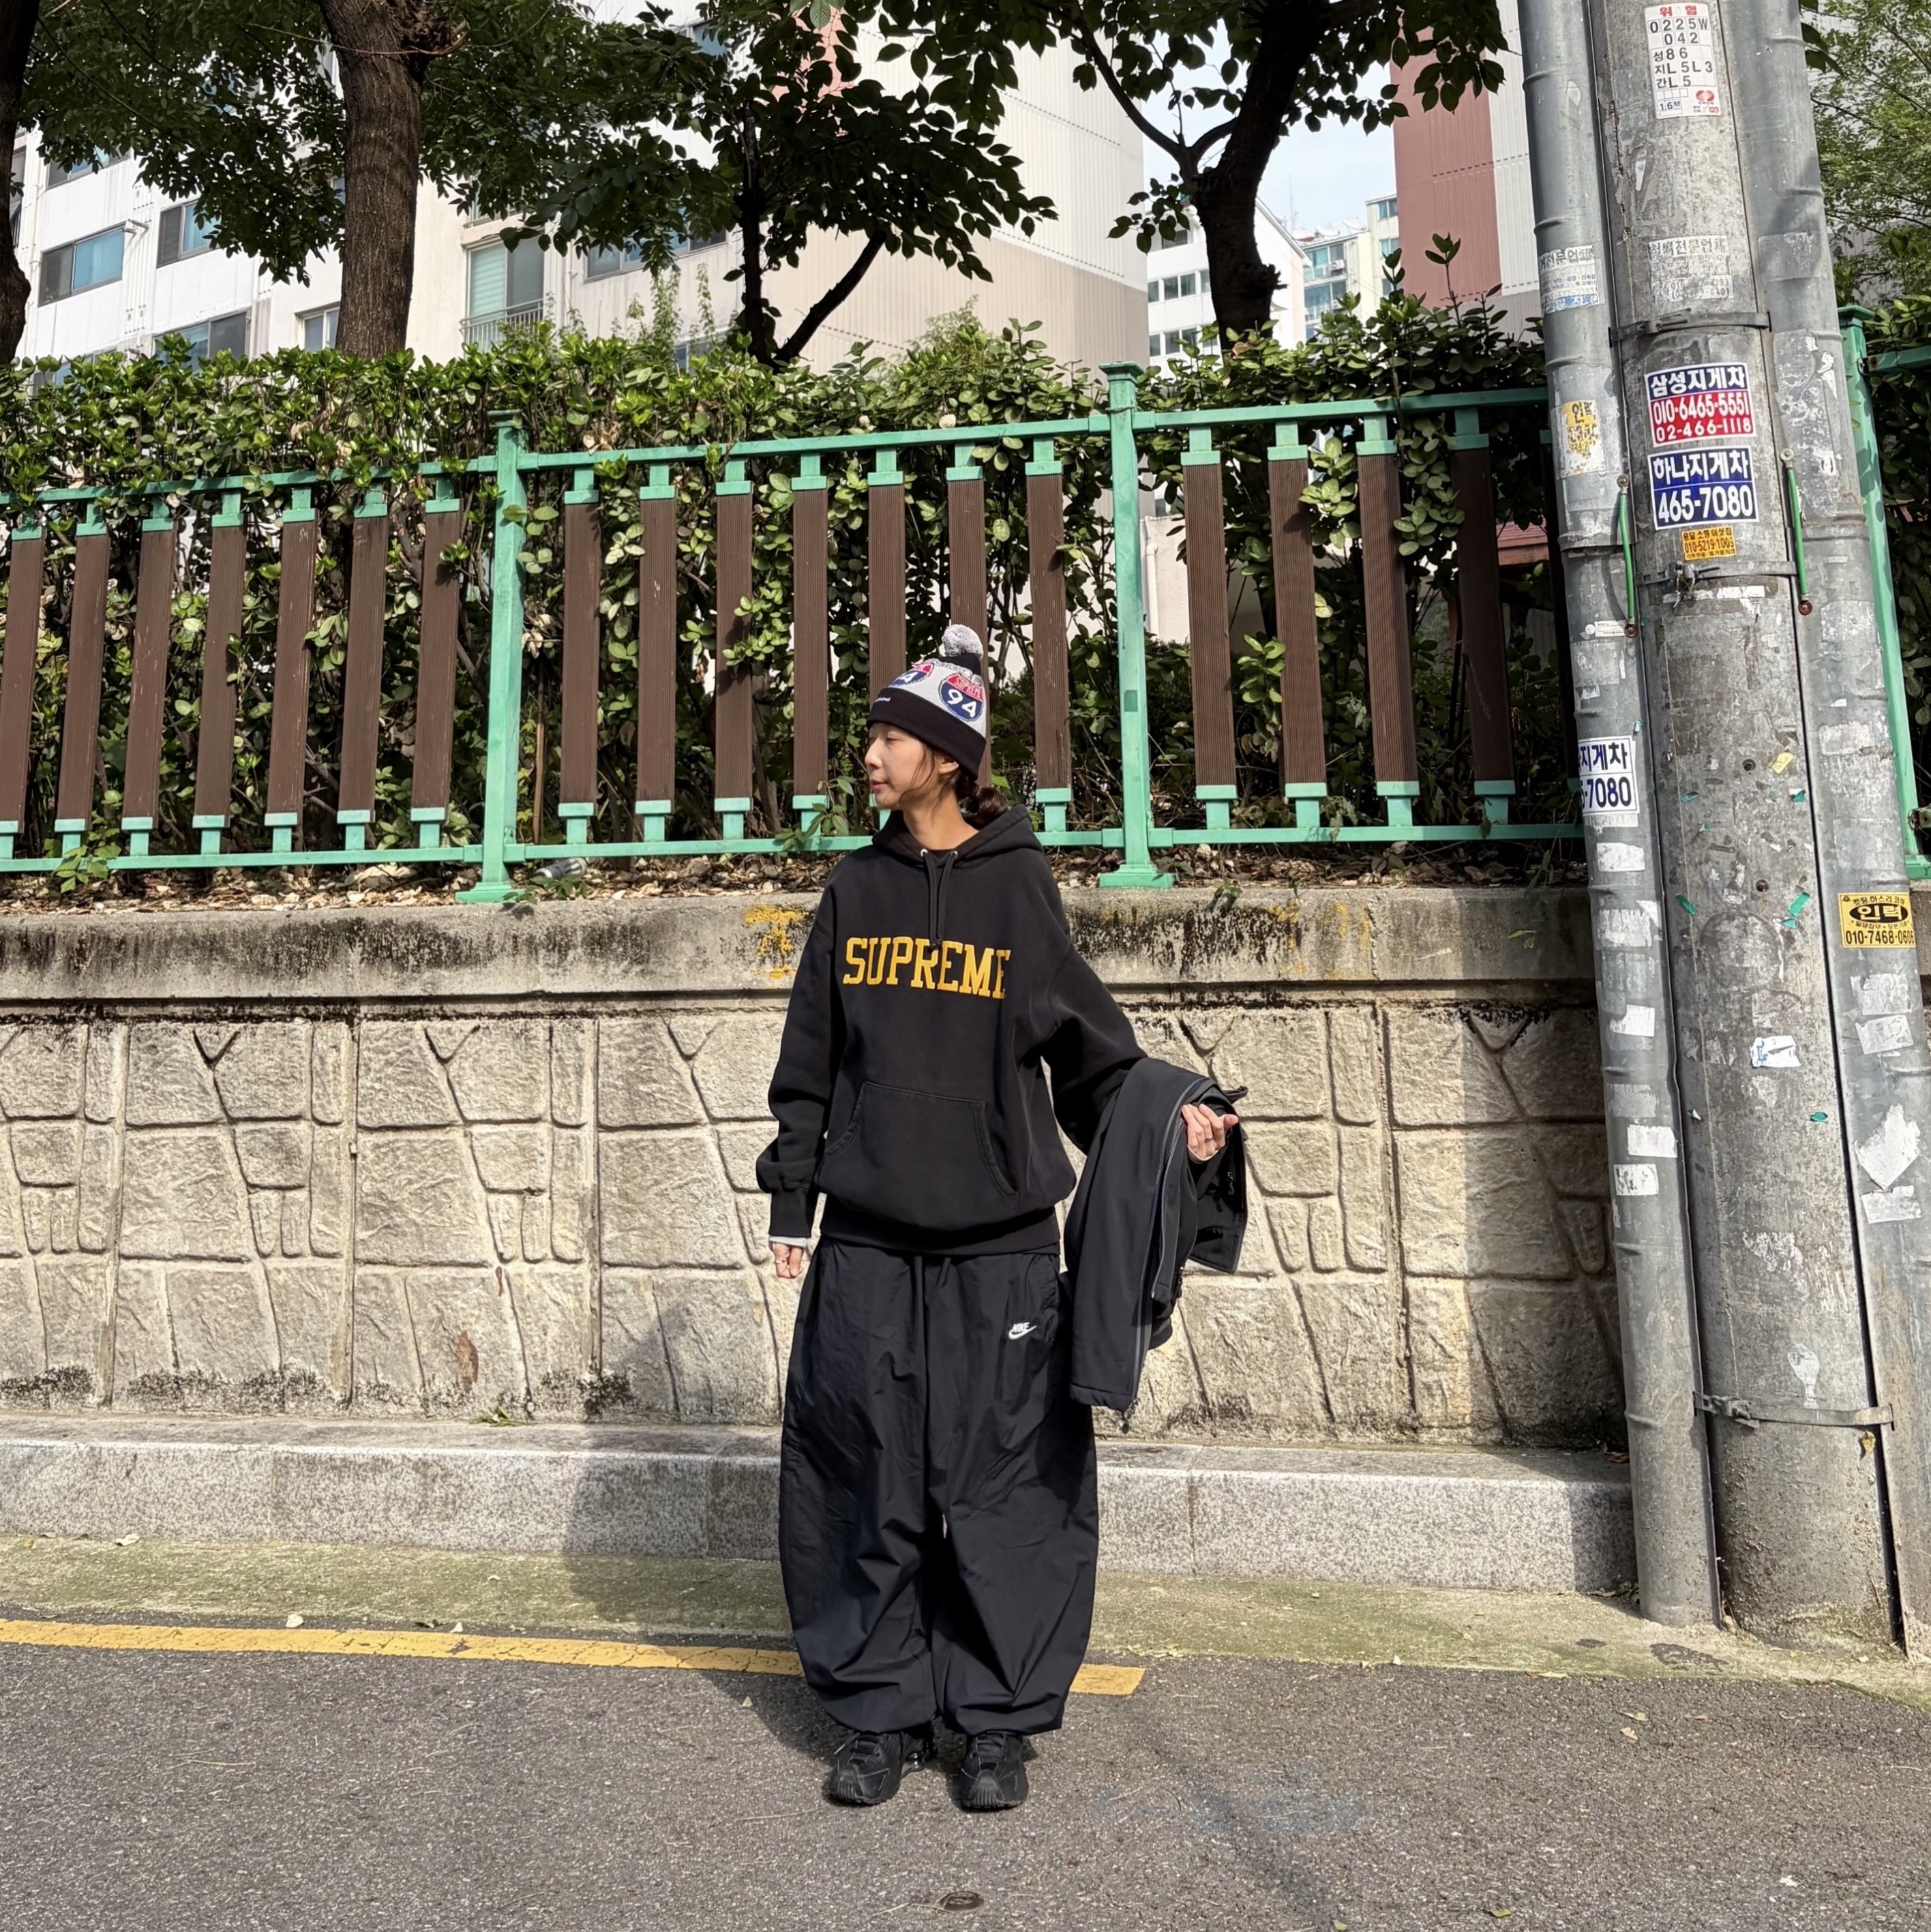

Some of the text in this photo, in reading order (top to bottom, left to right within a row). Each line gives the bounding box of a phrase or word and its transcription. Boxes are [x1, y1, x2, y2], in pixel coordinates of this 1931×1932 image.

[1650, 365, 1746, 398] 삼성지게차
[1653, 391, 1750, 425] 010-6465-5551
[1656, 417, 1752, 442] 02-466-1118
[1653, 449, 1748, 485] 하나지게차
[1658, 485, 1754, 523] 465-7080
[947, 689, 977, 719] 94
[955, 678, 983, 701] SUPREM
[1579, 742, 1628, 772] 지게차
[1857, 905, 1902, 920] 인력
[843, 936, 1011, 999] SUPREME
[1011, 1322, 1030, 1333] NIKE
